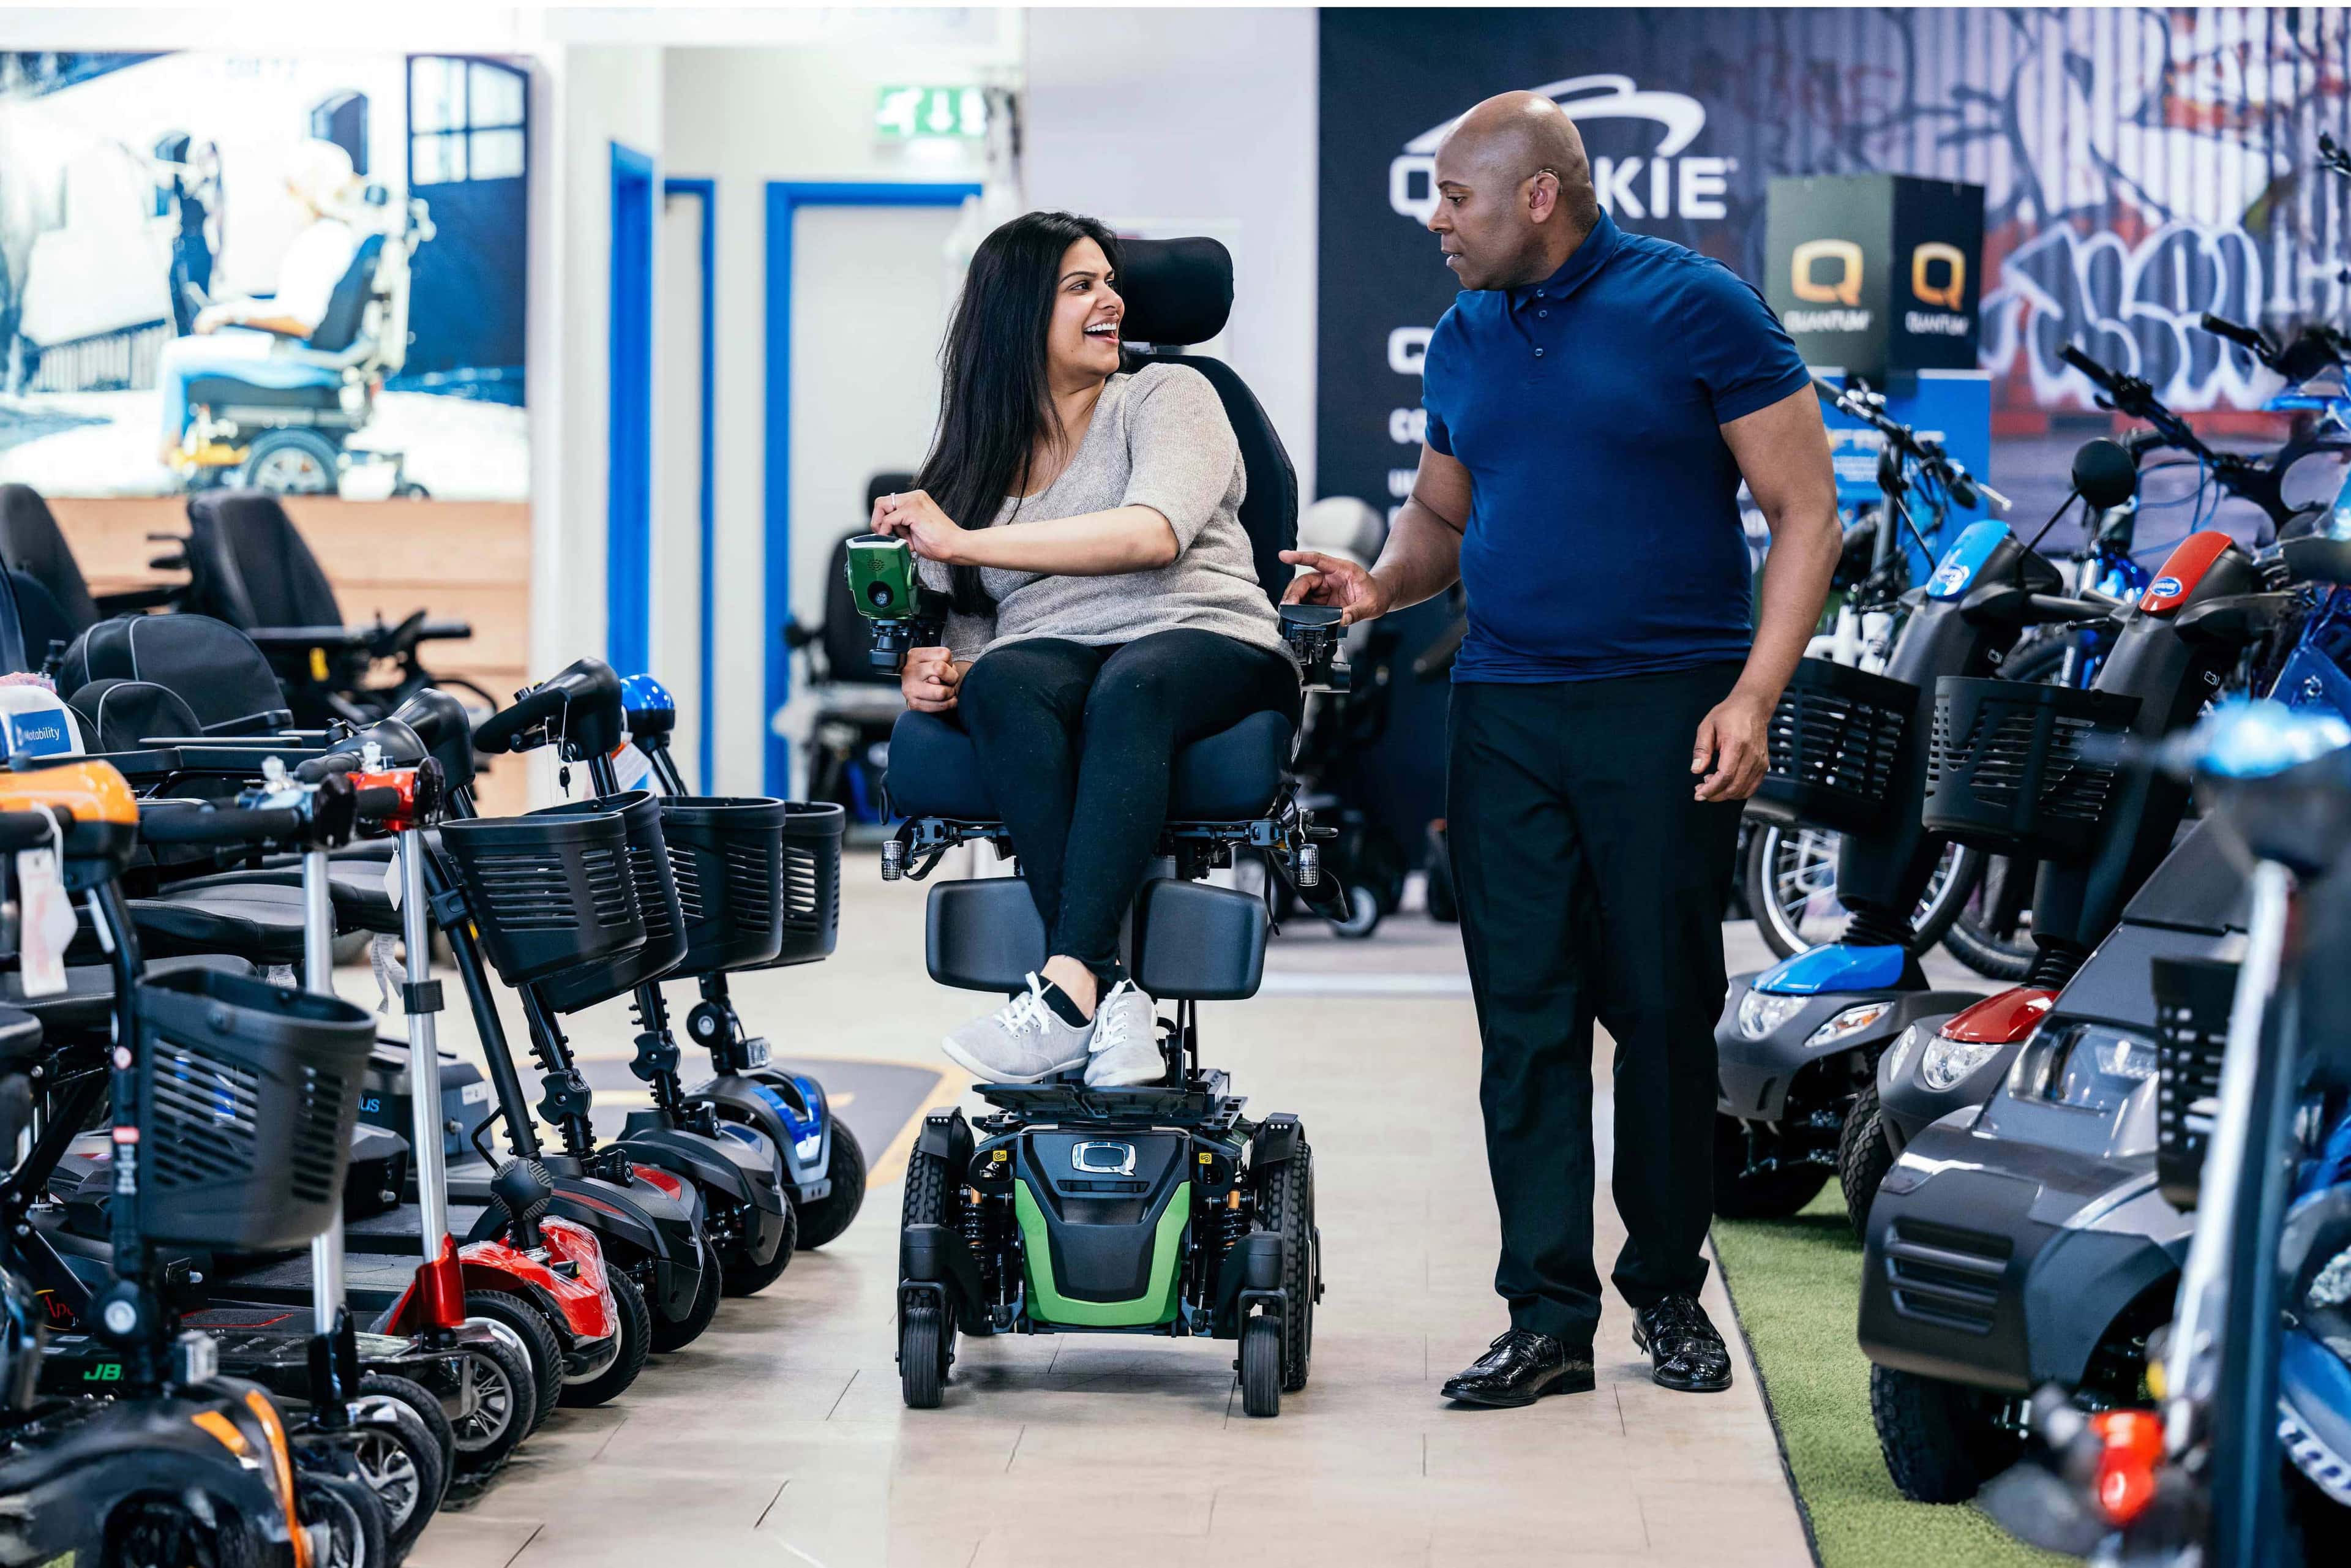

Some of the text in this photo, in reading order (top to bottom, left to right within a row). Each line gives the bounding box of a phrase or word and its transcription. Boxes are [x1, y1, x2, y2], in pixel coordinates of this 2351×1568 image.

[1389, 156, 1727, 224] QKIE
[1791, 239, 1863, 306] Q
[1911, 241, 1965, 311] Q
[1905, 311, 1969, 336] QUANTUM
[358, 1093, 380, 1113] lus
[1071, 1140, 1136, 1176] Q
